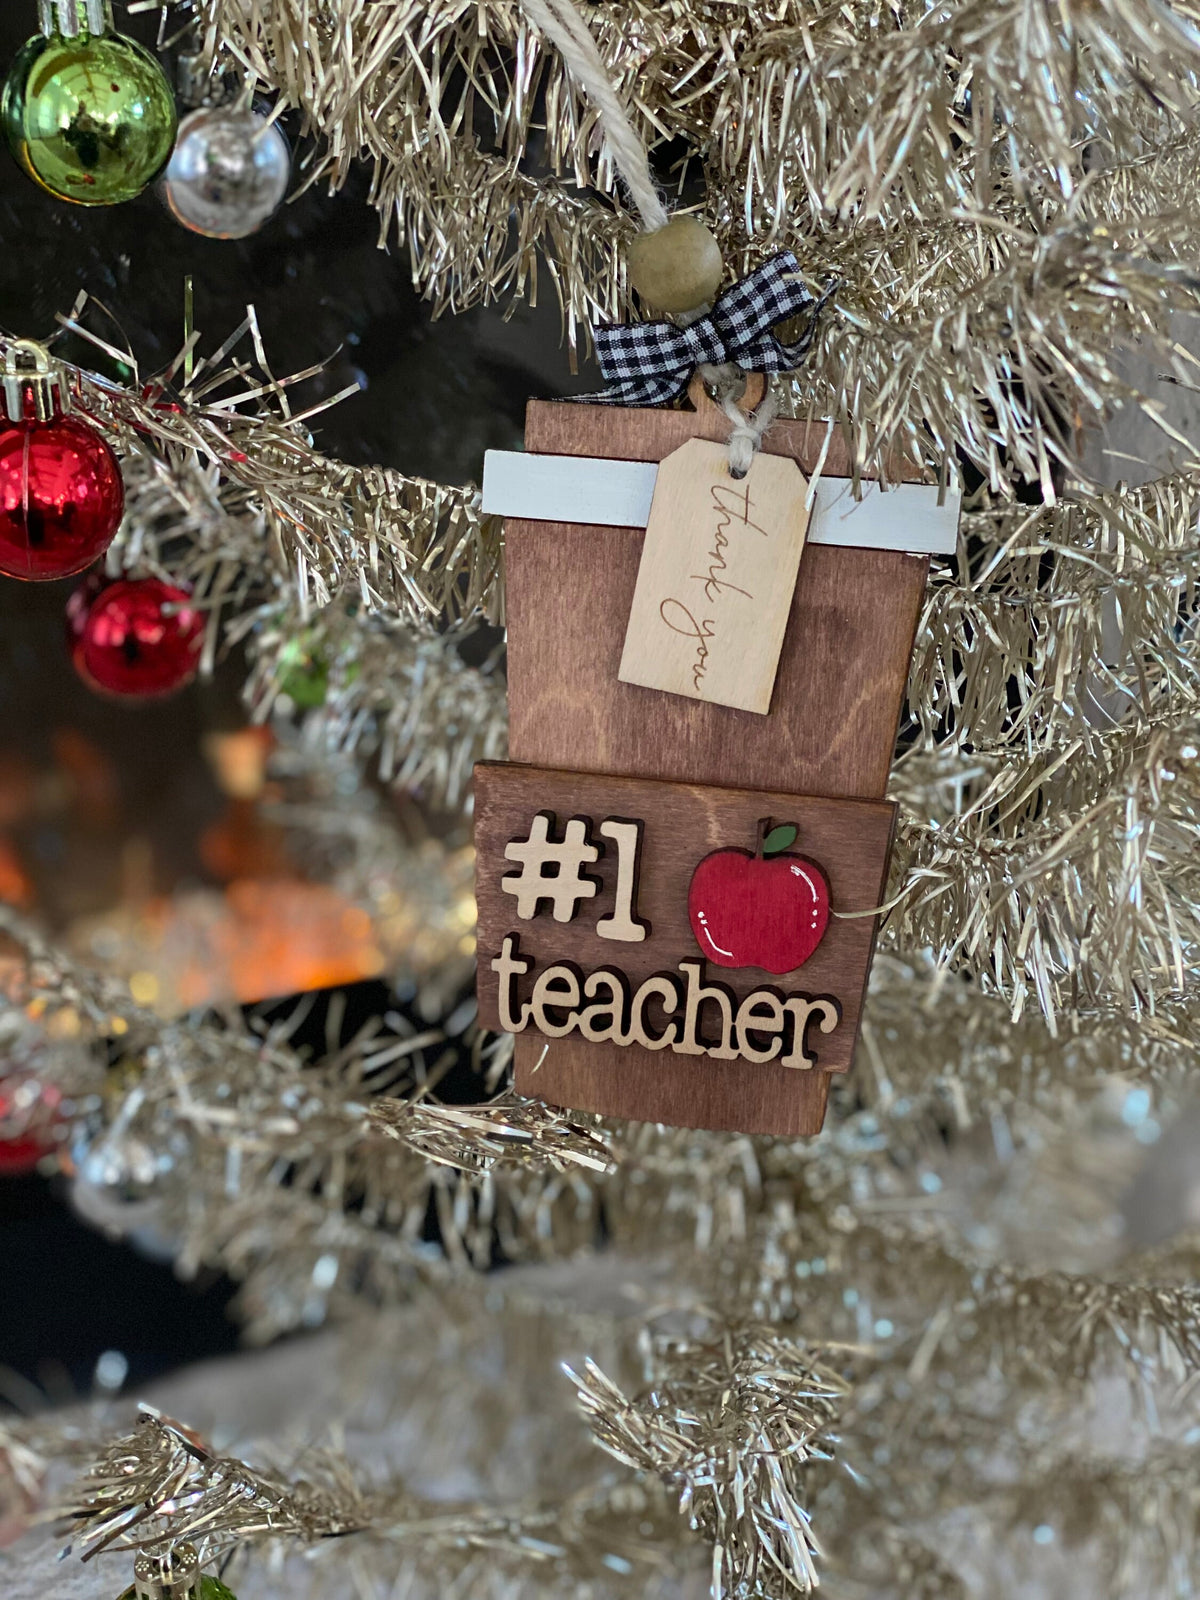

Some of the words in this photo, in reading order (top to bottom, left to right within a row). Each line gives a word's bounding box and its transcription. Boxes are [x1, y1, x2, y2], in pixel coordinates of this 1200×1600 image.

[690, 484, 768, 603] thank
[660, 598, 716, 691] you
[501, 813, 647, 942] #1
[490, 936, 839, 1070] teacher
